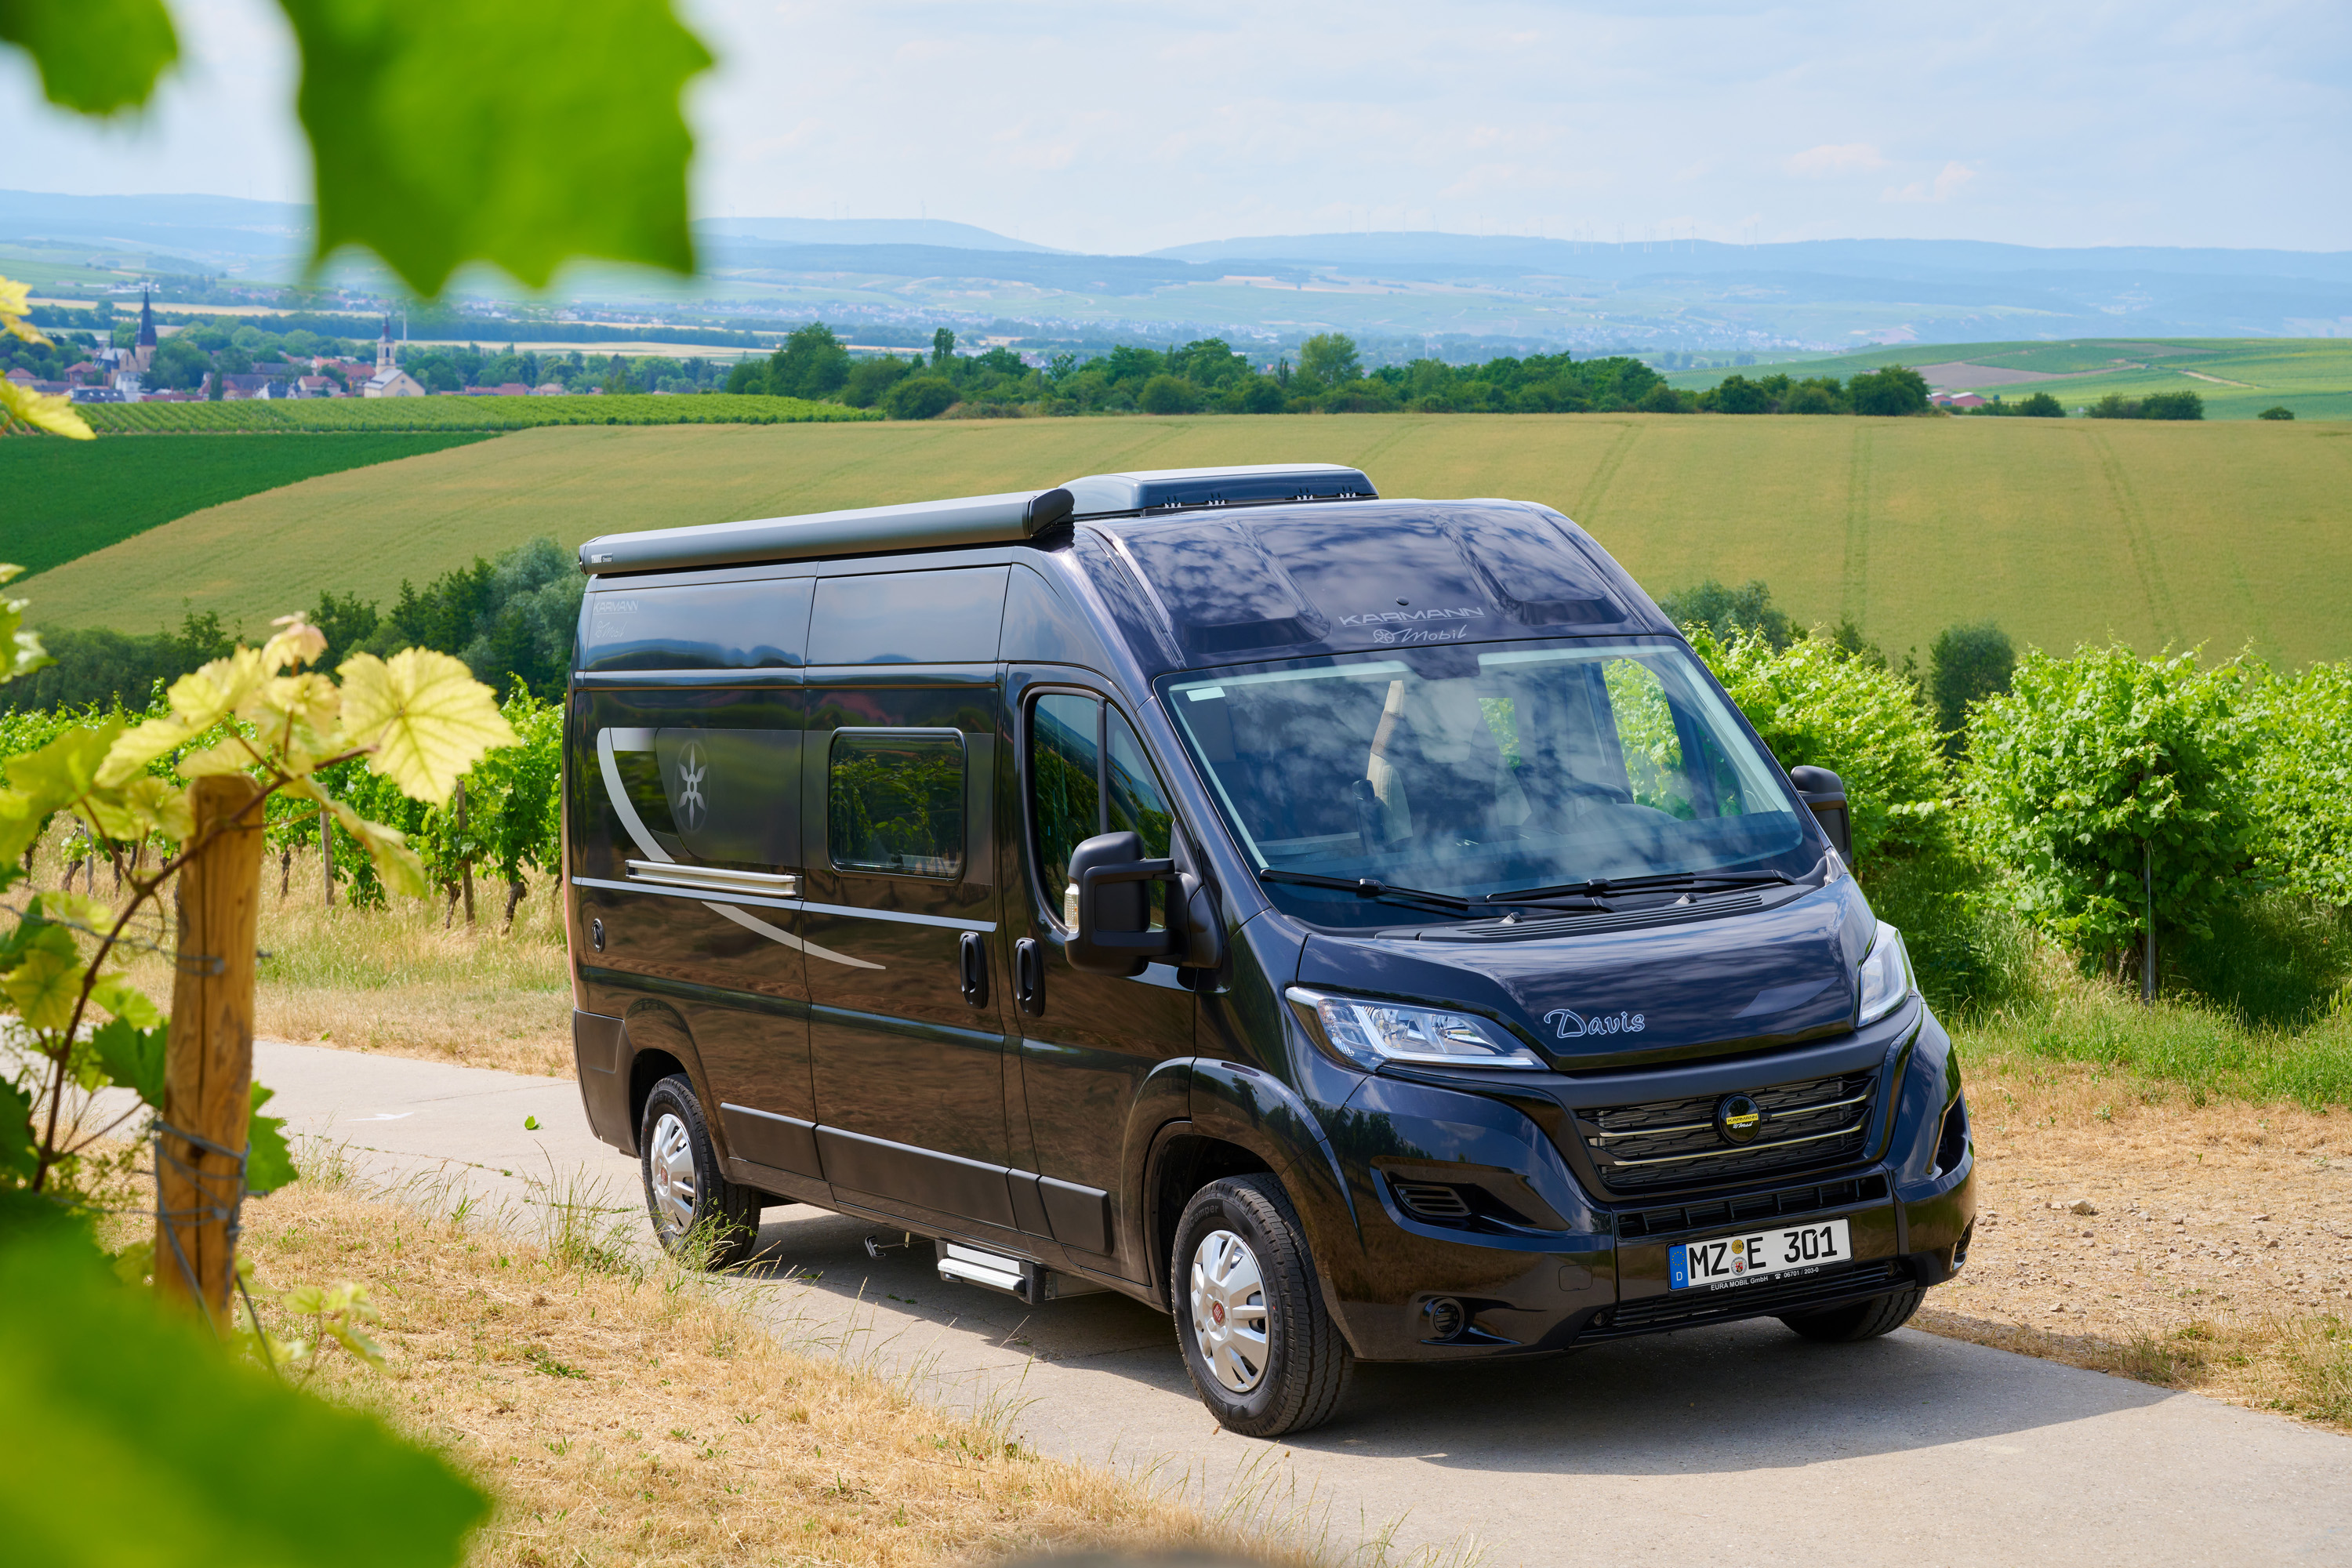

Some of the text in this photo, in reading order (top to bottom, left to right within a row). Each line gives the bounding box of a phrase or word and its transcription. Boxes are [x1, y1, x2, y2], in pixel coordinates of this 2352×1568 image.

[593, 601, 639, 612] KARMANN
[1338, 607, 1486, 626] KARMANN
[1392, 624, 1467, 643] Mobil
[1544, 1008, 1646, 1038] Davis
[1688, 1242, 1730, 1279] MZ
[1746, 1236, 1766, 1270] E
[1783, 1225, 1838, 1263] 301
[1676, 1272, 1682, 1281] D
[1711, 1282, 1729, 1291] EURA
[1730, 1279, 1749, 1288] MOBIL
[1750, 1276, 1769, 1284] GmbH
[1784, 1269, 1800, 1278] 06701
